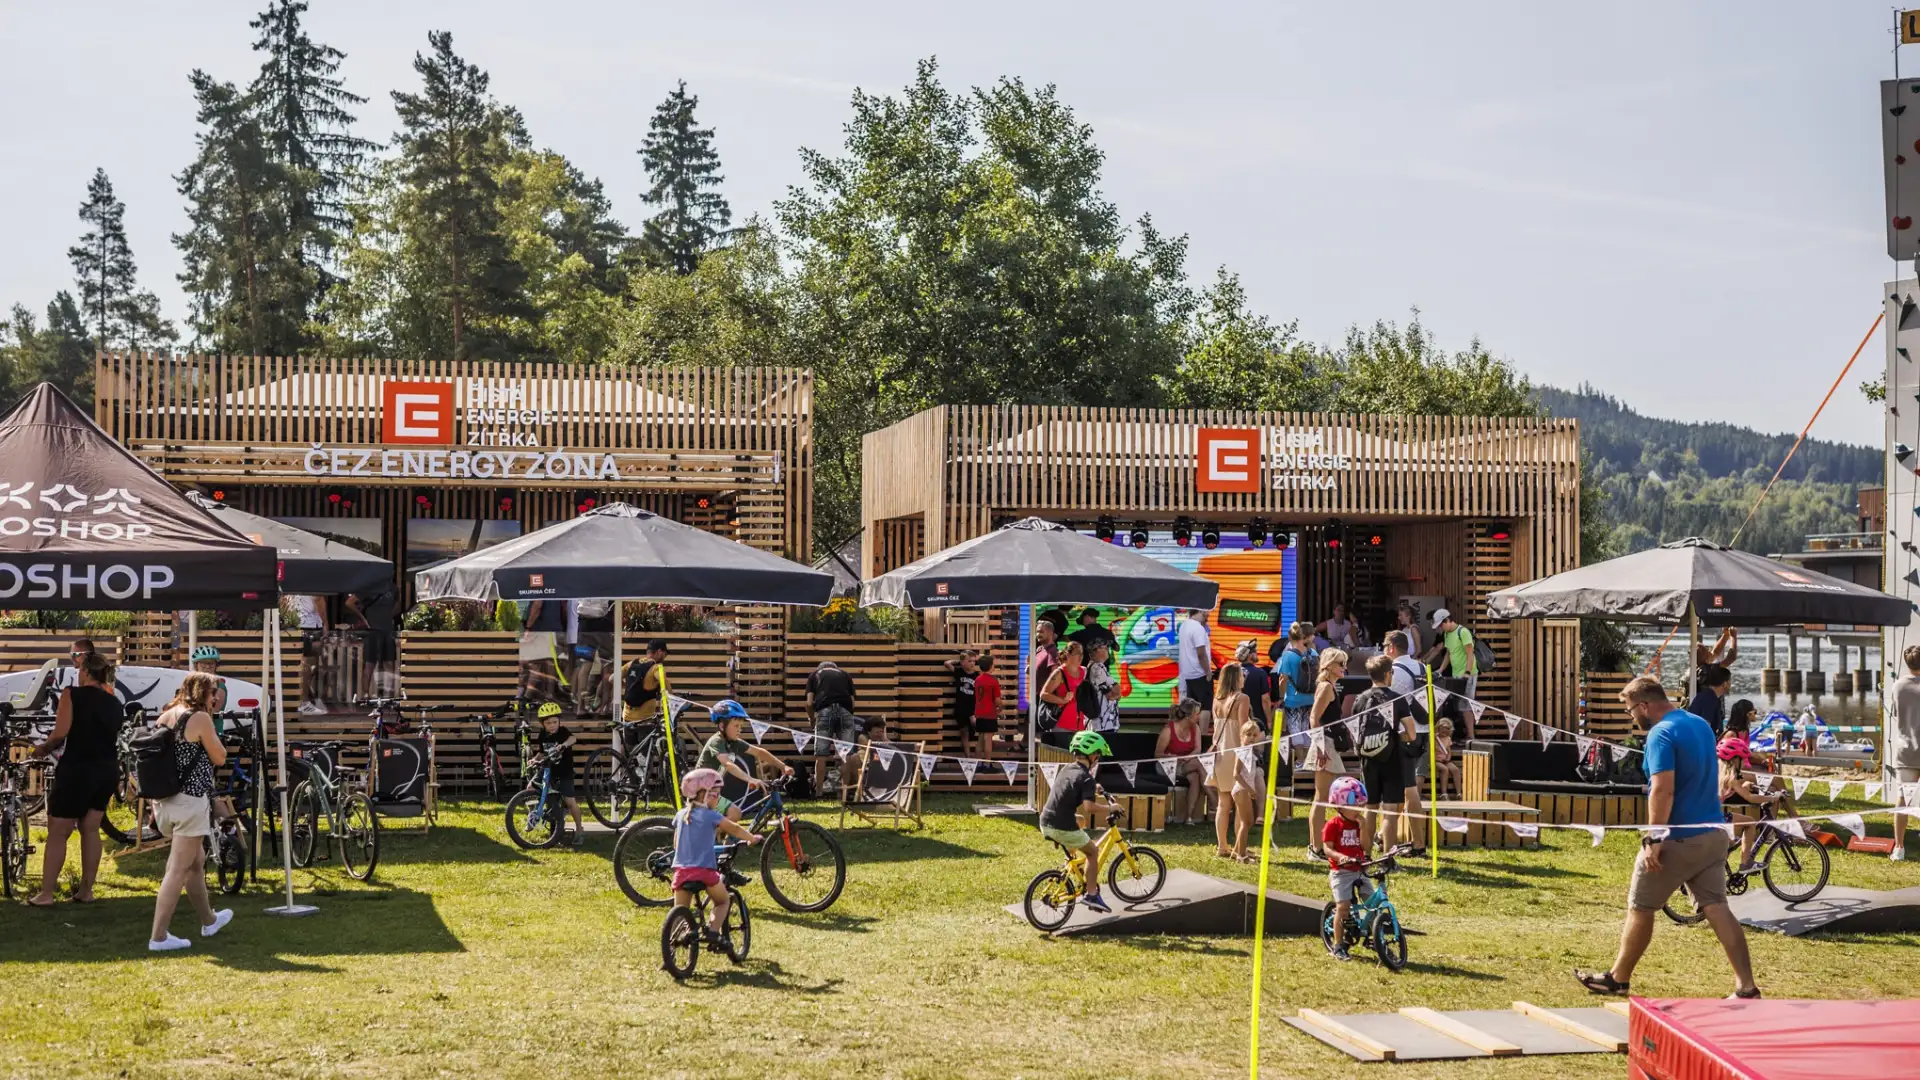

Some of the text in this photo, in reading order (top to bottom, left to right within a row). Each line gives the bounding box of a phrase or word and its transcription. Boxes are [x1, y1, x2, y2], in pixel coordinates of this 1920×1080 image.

[467, 409, 552, 425] ENERGIE
[467, 427, 540, 446] ZÍTŘKA
[304, 442, 621, 479] ČEZ ENERGY ZÓNA
[1272, 454, 1349, 469] ENERGIE
[1272, 471, 1337, 489] ZÍTŘKA
[1363, 730, 1389, 750] NIKE
